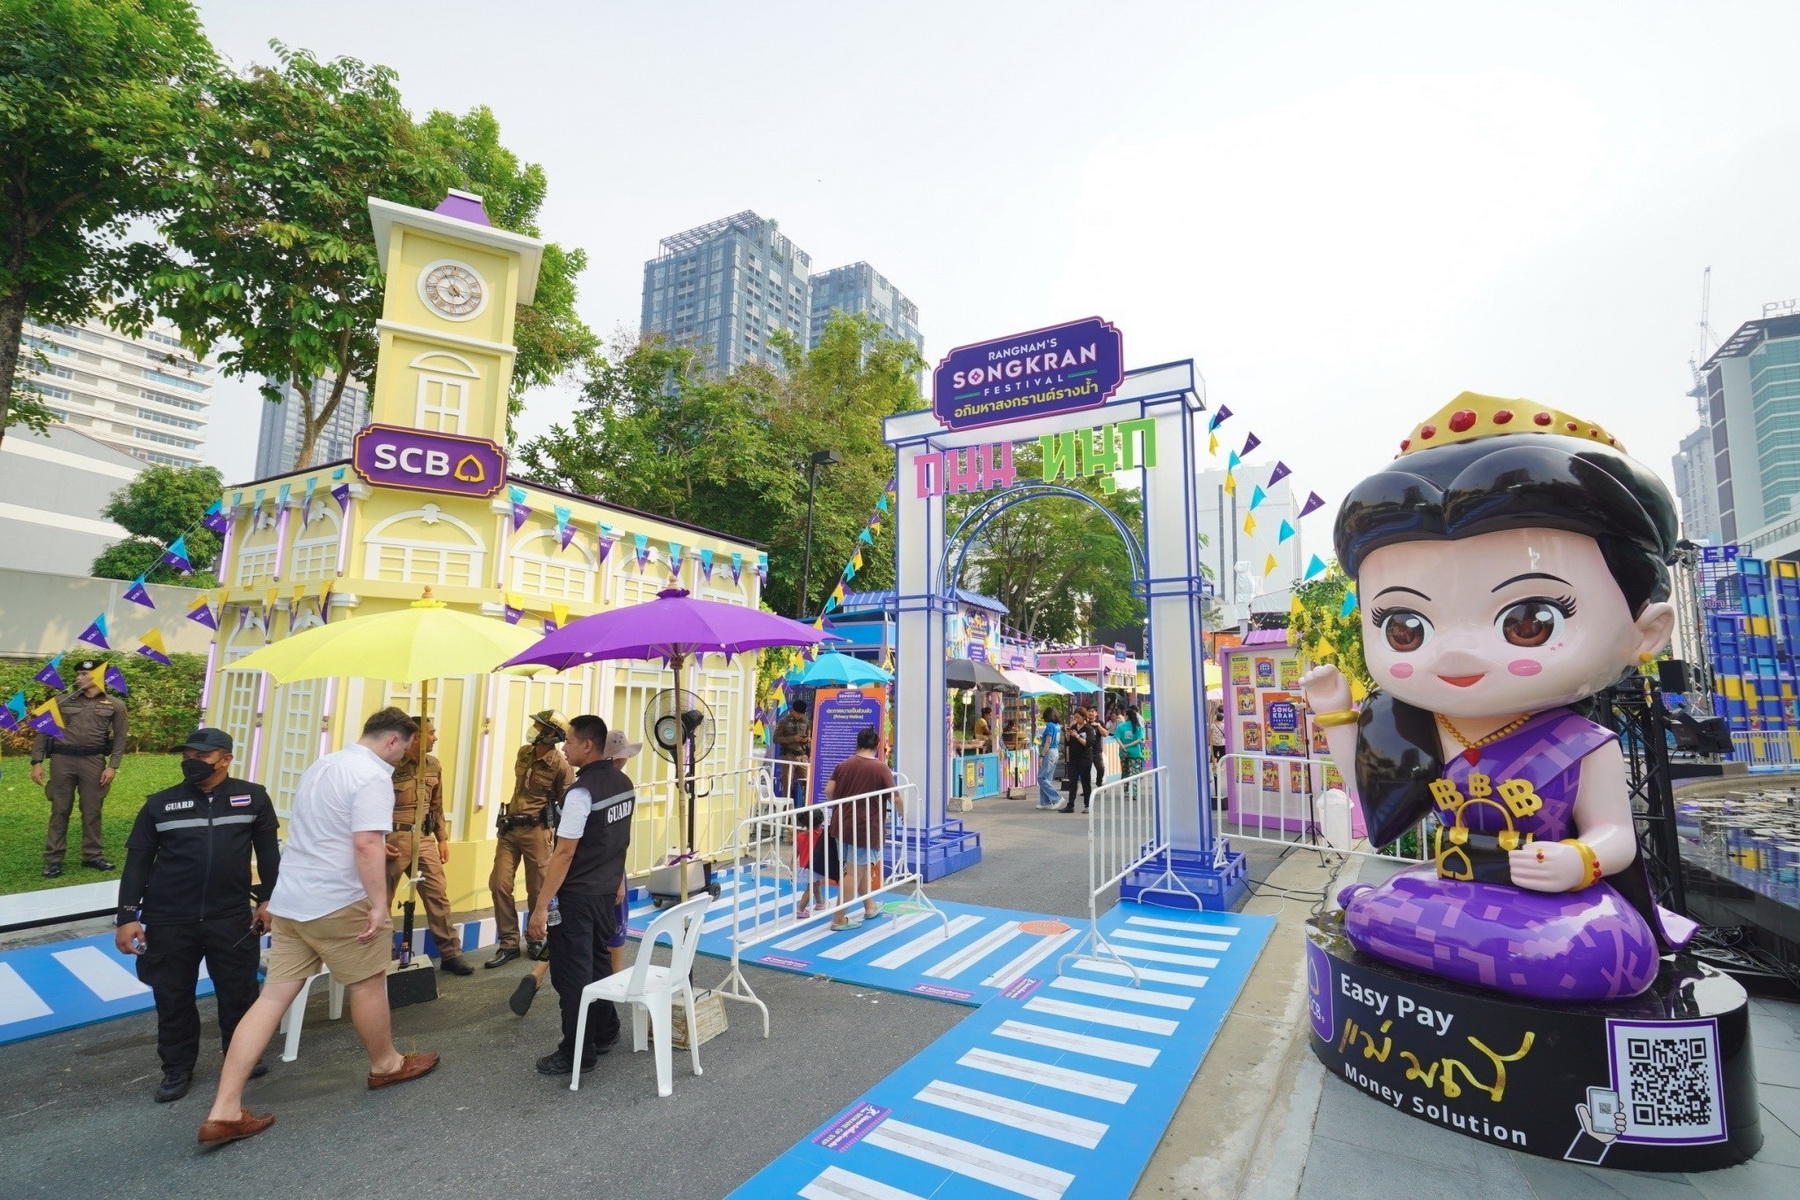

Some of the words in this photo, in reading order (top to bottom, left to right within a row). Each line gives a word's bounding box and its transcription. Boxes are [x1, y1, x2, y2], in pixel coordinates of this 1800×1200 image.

[952, 342, 1098, 389] SONGKRAN
[988, 338, 1058, 361] RANGNAM'S
[954, 378, 1098, 418] อภิมหาสงกรานต์รางน้ำ
[984, 375, 1064, 397] FESTIVAL
[374, 443, 450, 477] SCB
[913, 441, 1017, 499] ถนน
[1039, 417, 1157, 495] หนุก
[165, 800, 195, 812] GUARD
[607, 800, 633, 824] GUARD
[1340, 972, 1390, 1016] Easy
[1397, 994, 1455, 1036] Pay
[1344, 1062, 1404, 1108] Money
[1412, 1096, 1528, 1146] Solution
